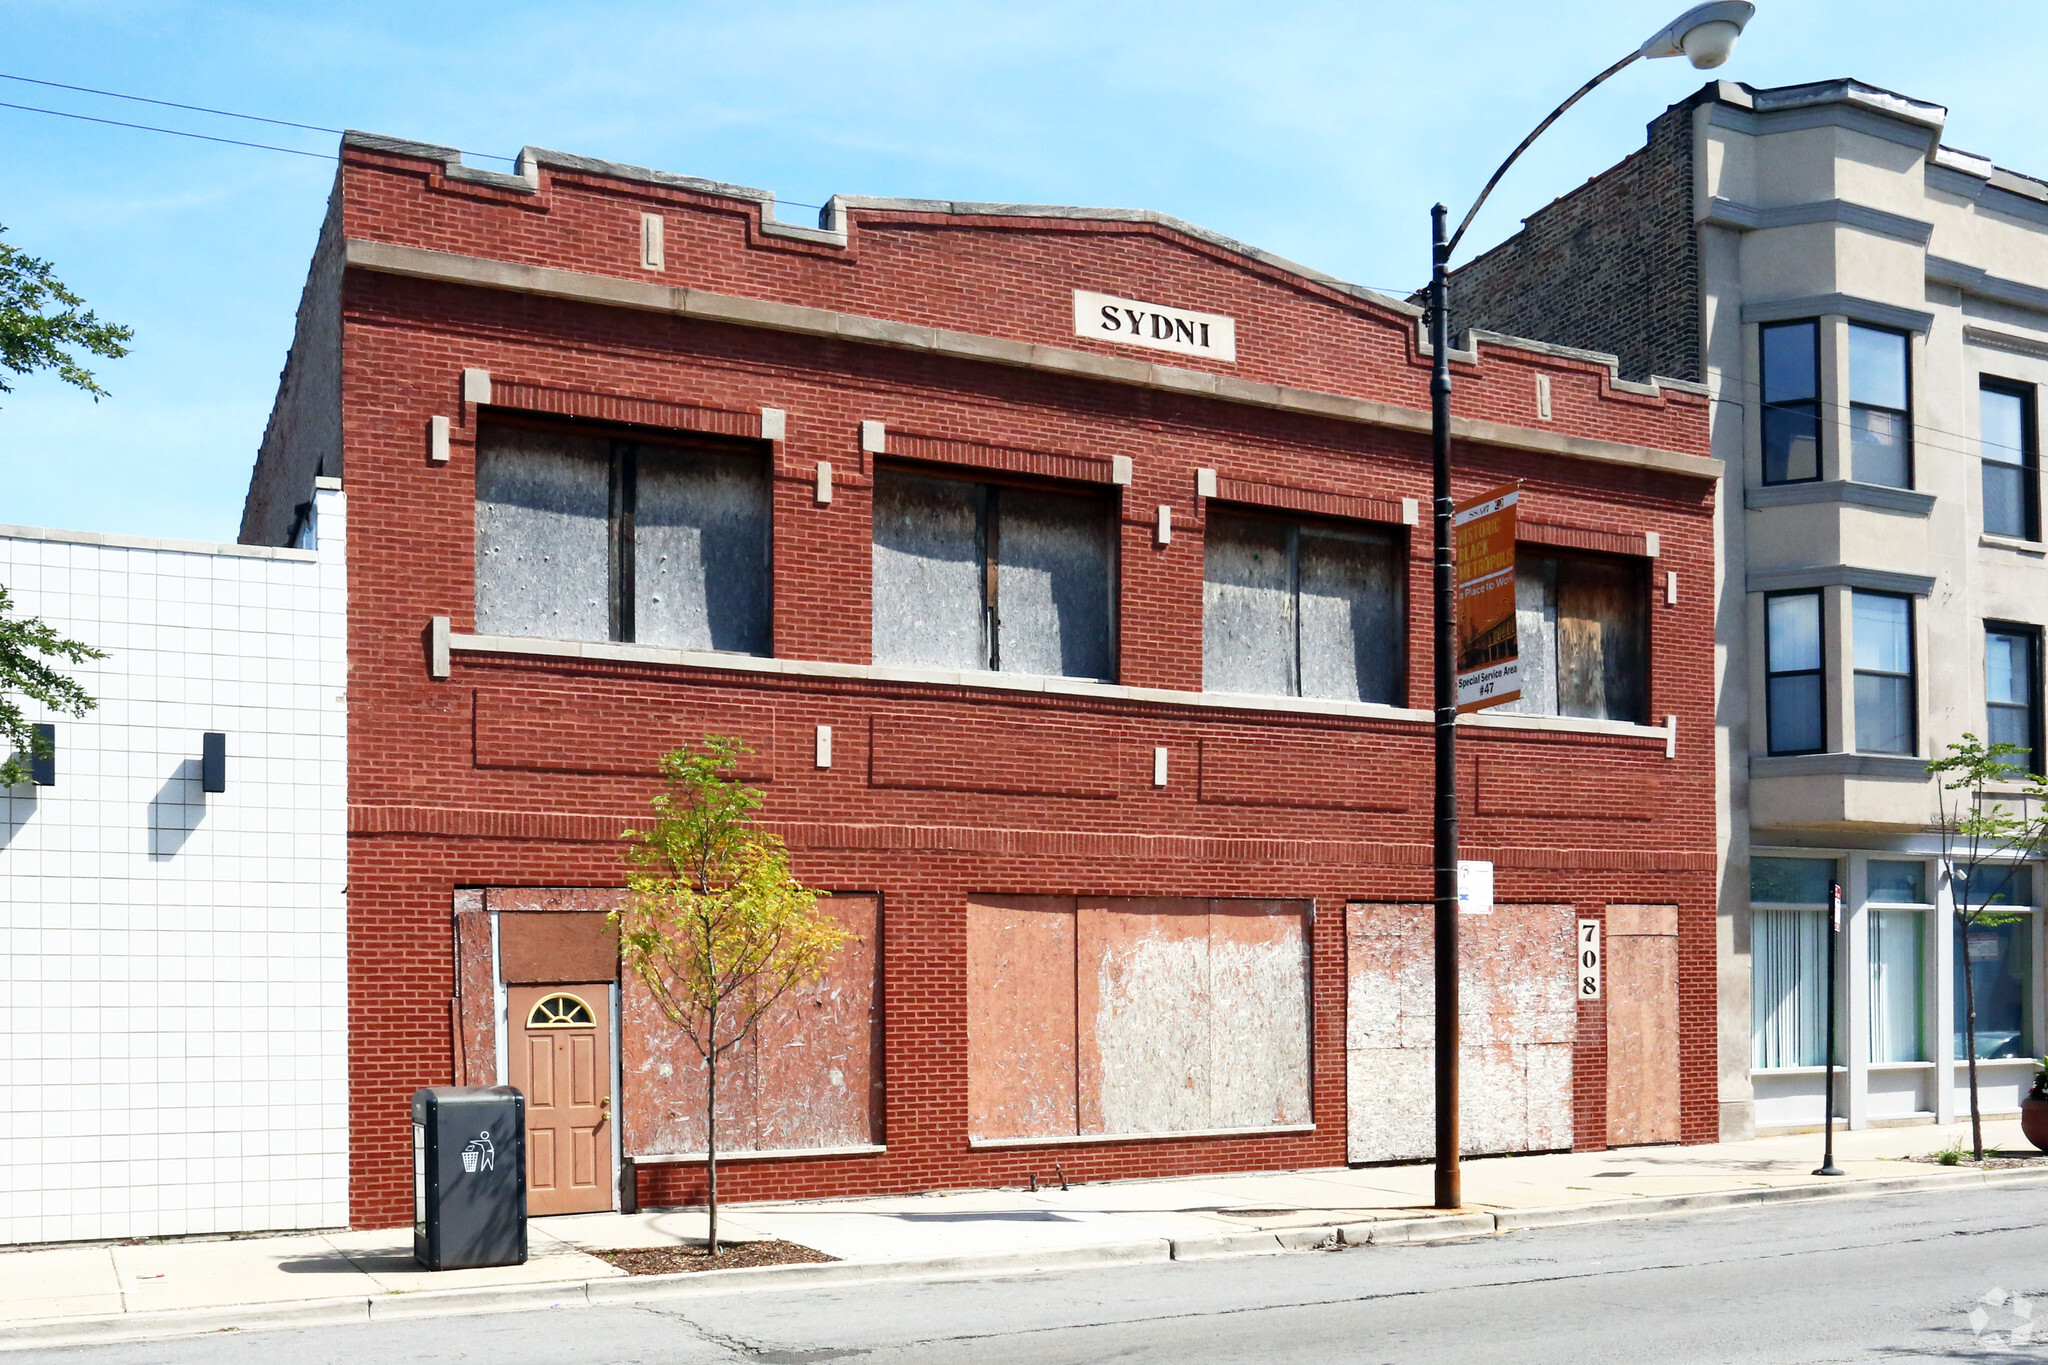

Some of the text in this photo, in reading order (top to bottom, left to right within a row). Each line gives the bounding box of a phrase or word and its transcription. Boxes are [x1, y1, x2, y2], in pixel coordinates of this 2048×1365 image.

[1101, 305, 1210, 347] SYDNI
[1459, 517, 1500, 546] HISTORIC
[1459, 540, 1489, 563] BLACK
[1459, 547, 1514, 580] METROPOLIS
[1464, 585, 1485, 597] Place
[1485, 581, 1495, 591] to
[1496, 574, 1514, 588] Work
[1458, 664, 1518, 689] Special Service Area
[1479, 682, 1495, 696] #47
[1582, 925, 1597, 995] 708
